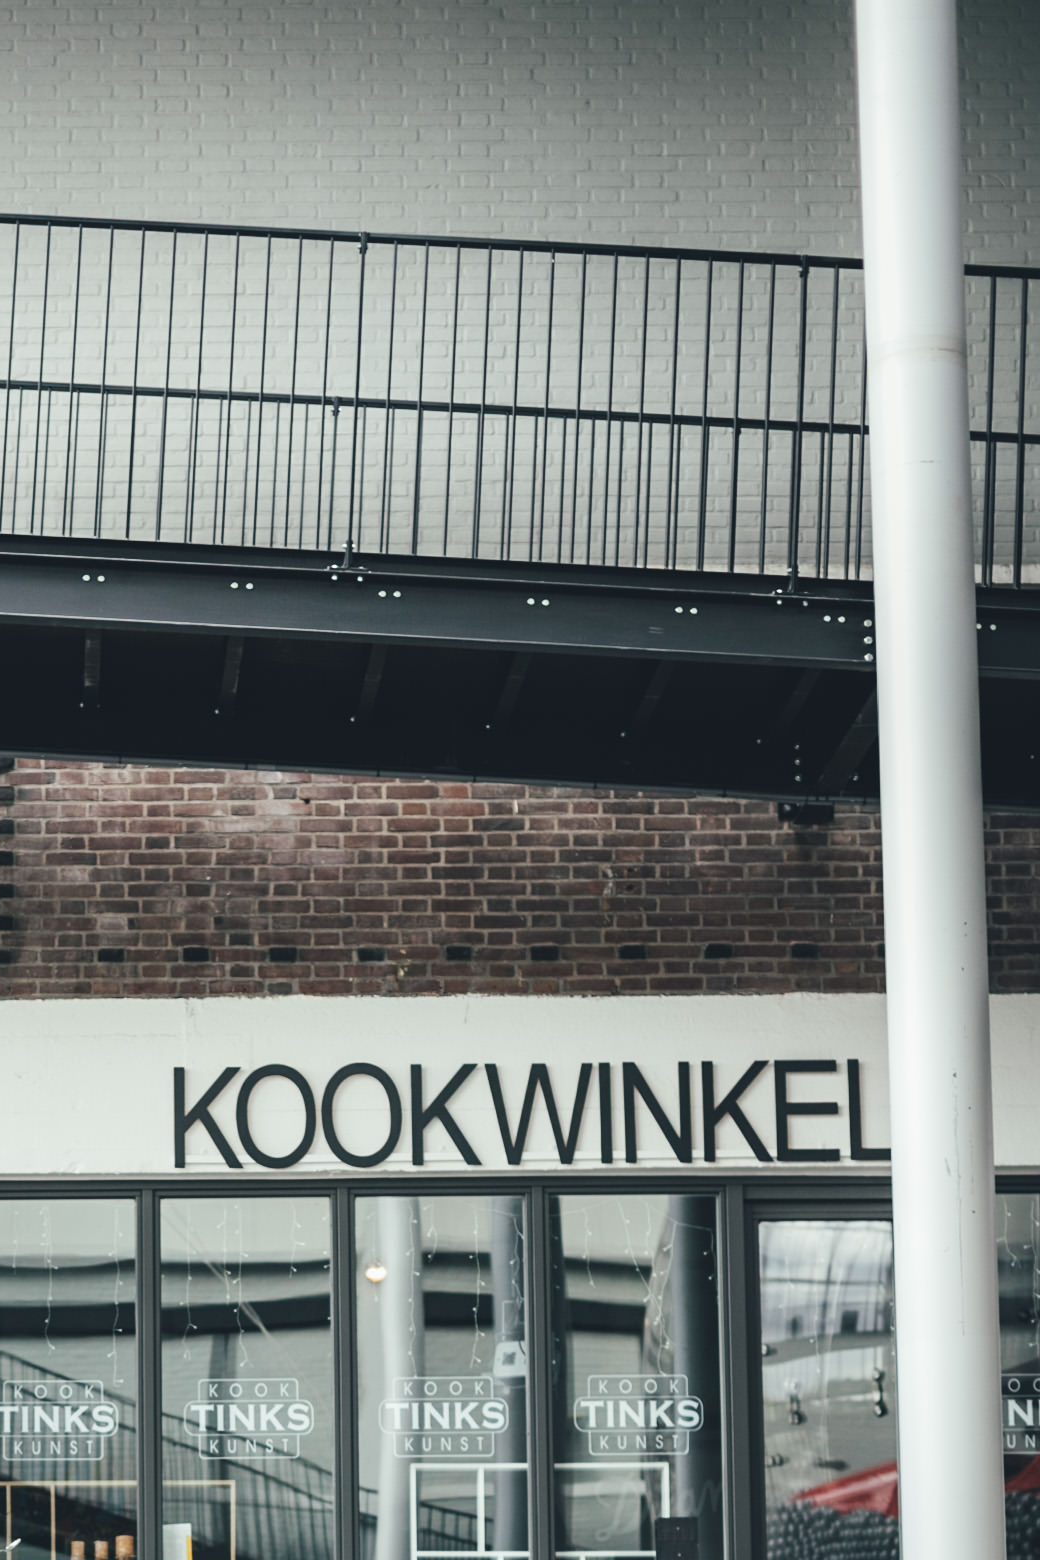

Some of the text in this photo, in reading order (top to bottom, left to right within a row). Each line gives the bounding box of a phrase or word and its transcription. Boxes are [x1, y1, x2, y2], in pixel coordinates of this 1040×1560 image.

[173, 1059, 891, 1169] KOOKWINKEL
[14, 1384, 94, 1399] KOOK
[209, 1383, 289, 1398] KOOK
[404, 1381, 484, 1396] KOOK
[599, 1379, 679, 1394] KOOK
[190, 1403, 310, 1431] TINKS
[385, 1402, 505, 1429] TINKS
[580, 1400, 700, 1428] TINKS
[15, 1440, 94, 1454] KUNST
[210, 1438, 289, 1453] KUNST
[405, 1437, 484, 1451] KUNST
[600, 1435, 679, 1449] KUNST
